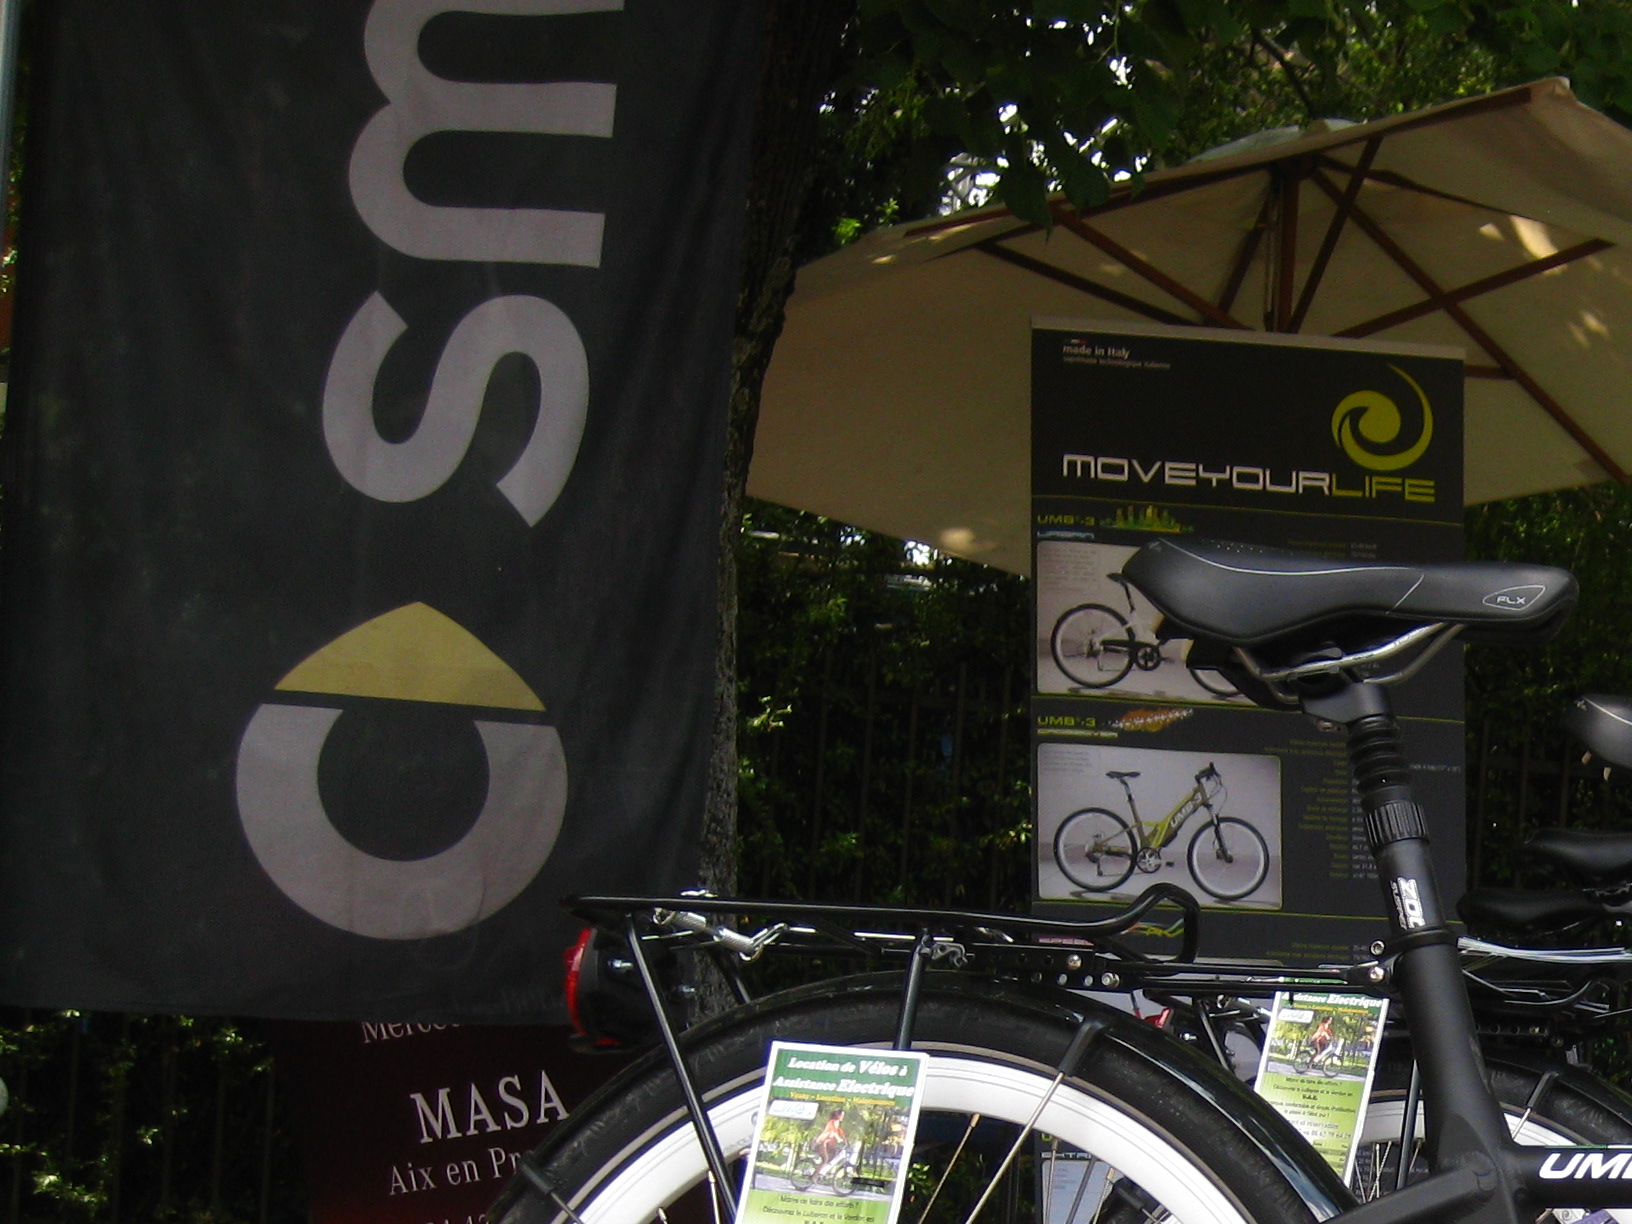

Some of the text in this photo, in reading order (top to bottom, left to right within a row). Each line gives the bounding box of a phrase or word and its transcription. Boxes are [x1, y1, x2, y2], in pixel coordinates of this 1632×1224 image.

[1063, 344, 1131, 359] made in Italy
[787, 1057, 839, 1073] Location
[840, 1061, 857, 1073] de
[858, 1060, 899, 1076] Vélos
[772, 1075, 915, 1099] Assistance Electrique
[410, 1069, 570, 1145] MASA
[389, 1162, 437, 1196] Aix
[446, 1159, 481, 1186] en
